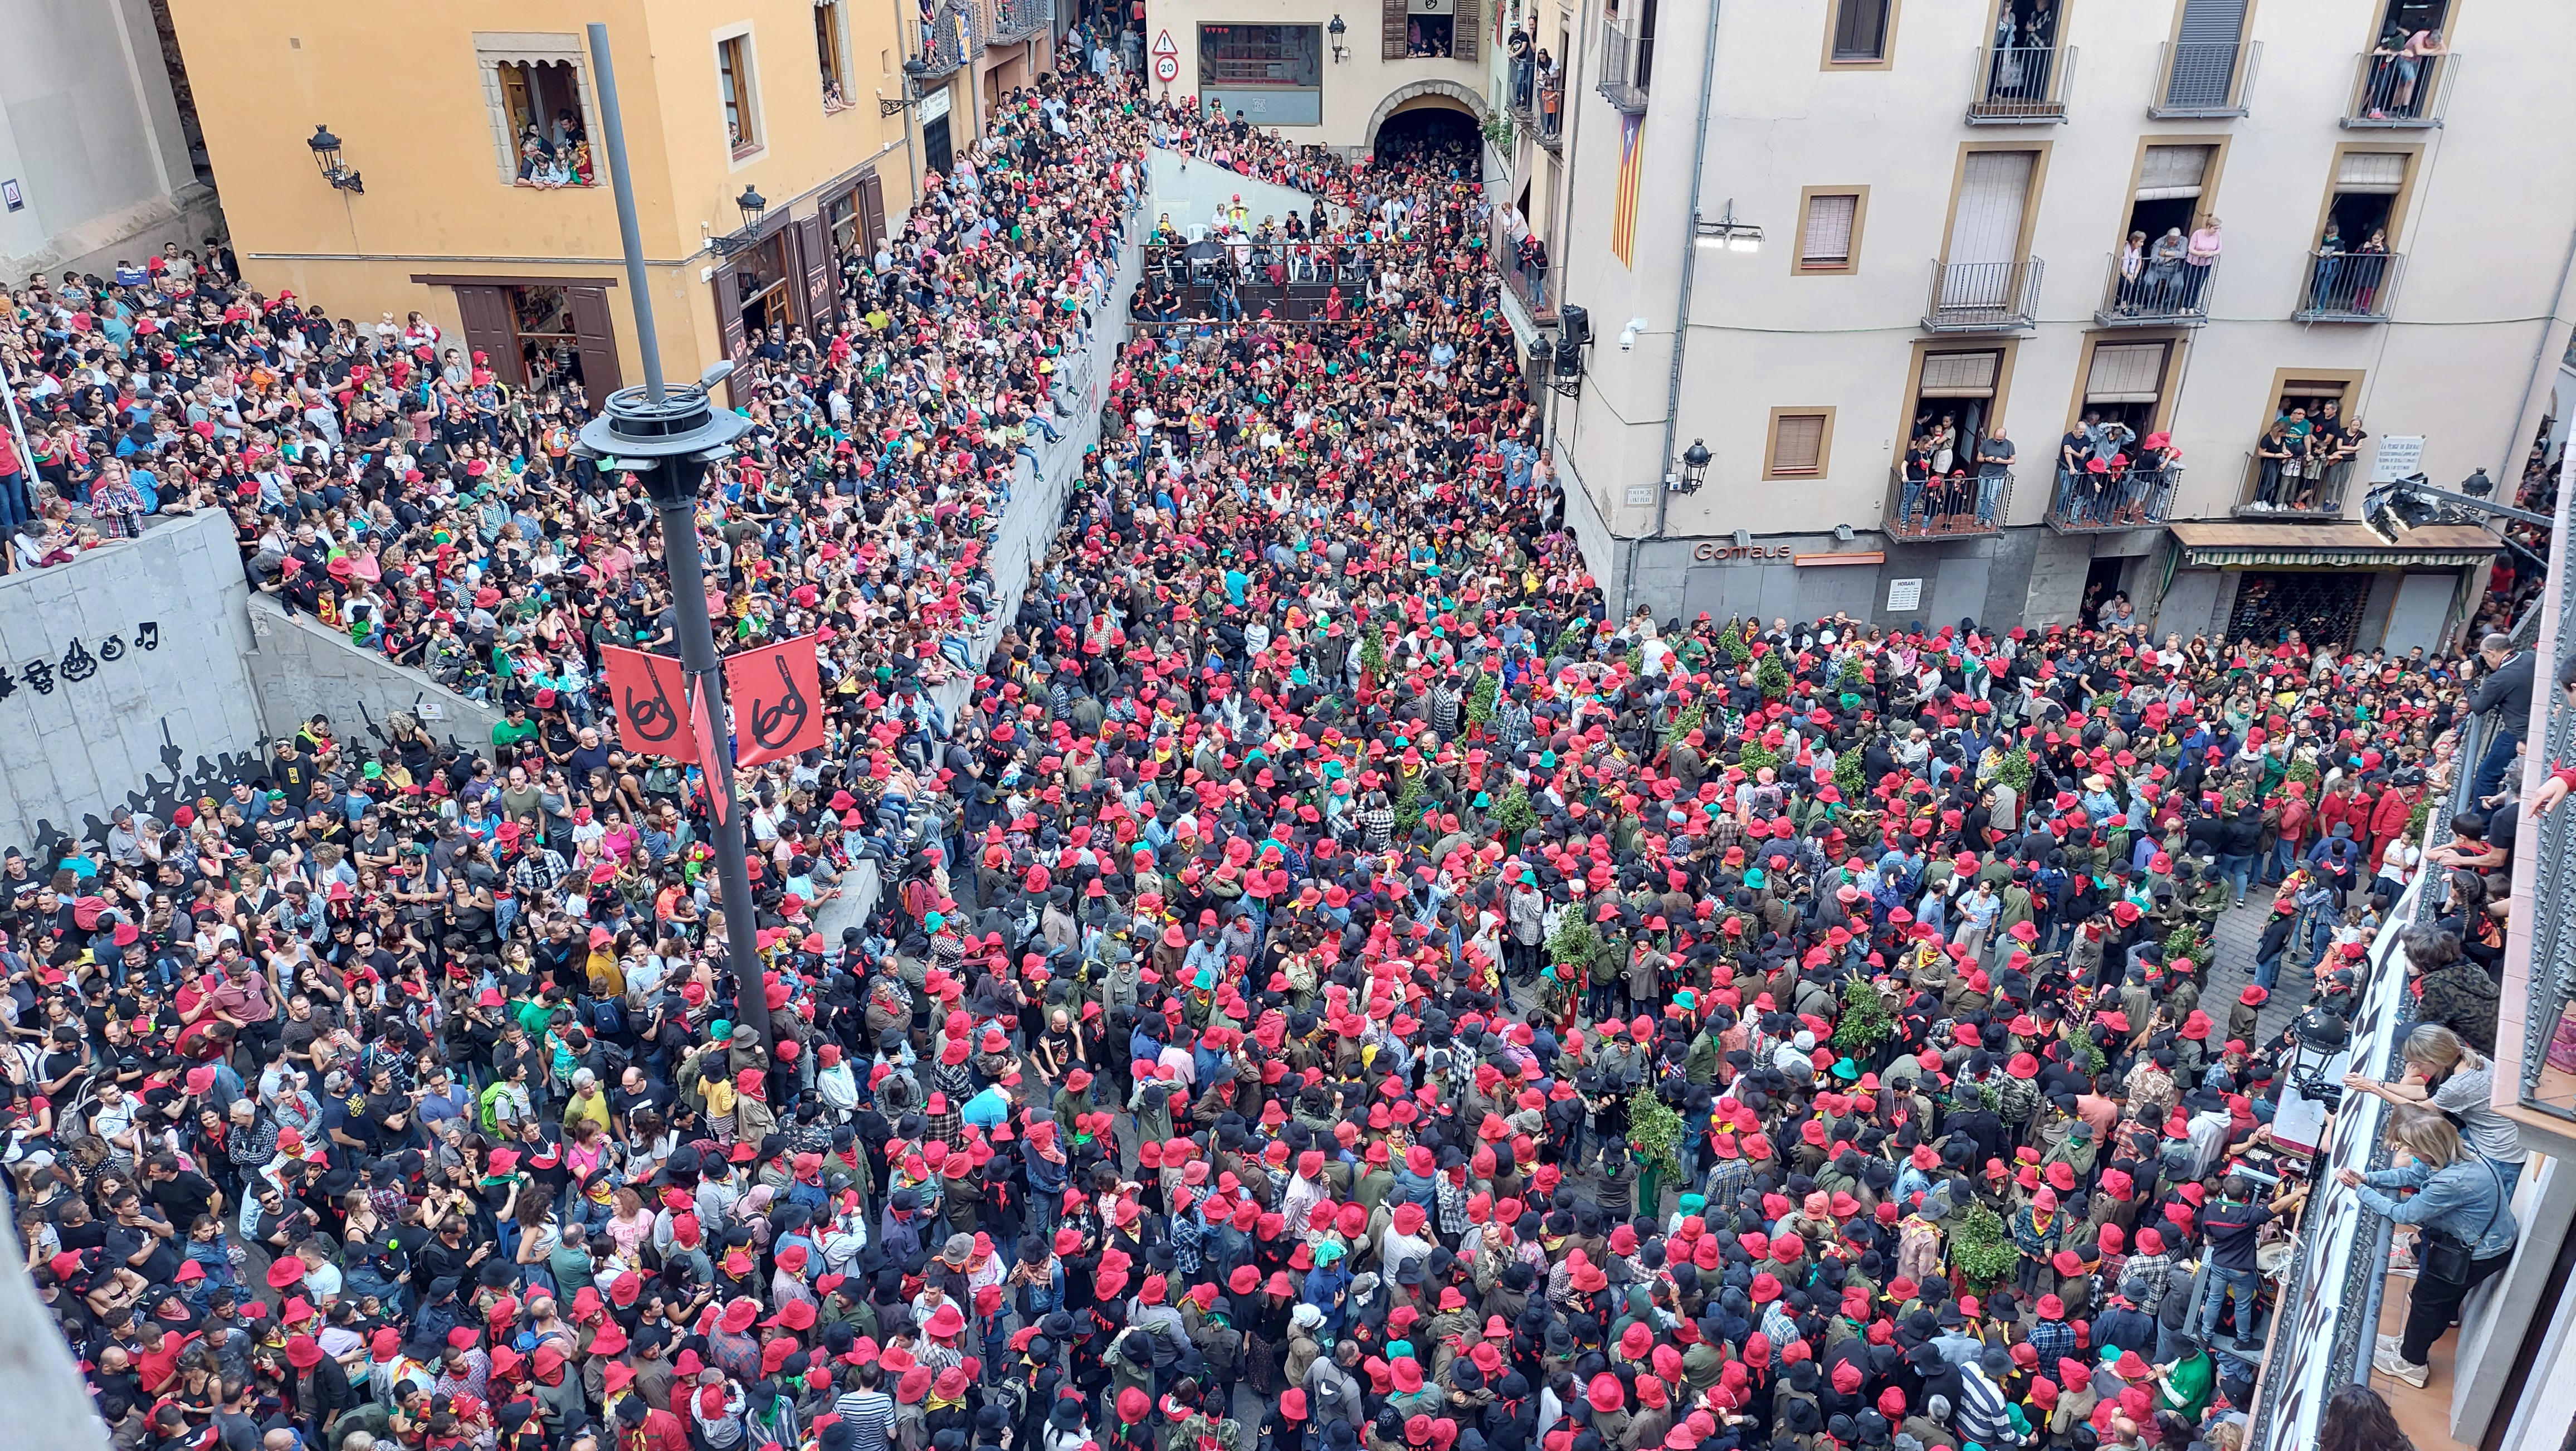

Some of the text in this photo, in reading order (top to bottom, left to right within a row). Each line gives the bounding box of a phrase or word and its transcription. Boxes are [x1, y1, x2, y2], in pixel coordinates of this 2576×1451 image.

[1160, 64, 1173, 72] 20
[1076, 381, 1093, 428] SEXISME
[274, 817, 295, 831] REPLAY
[1051, 1039, 1066, 1047] Patum
